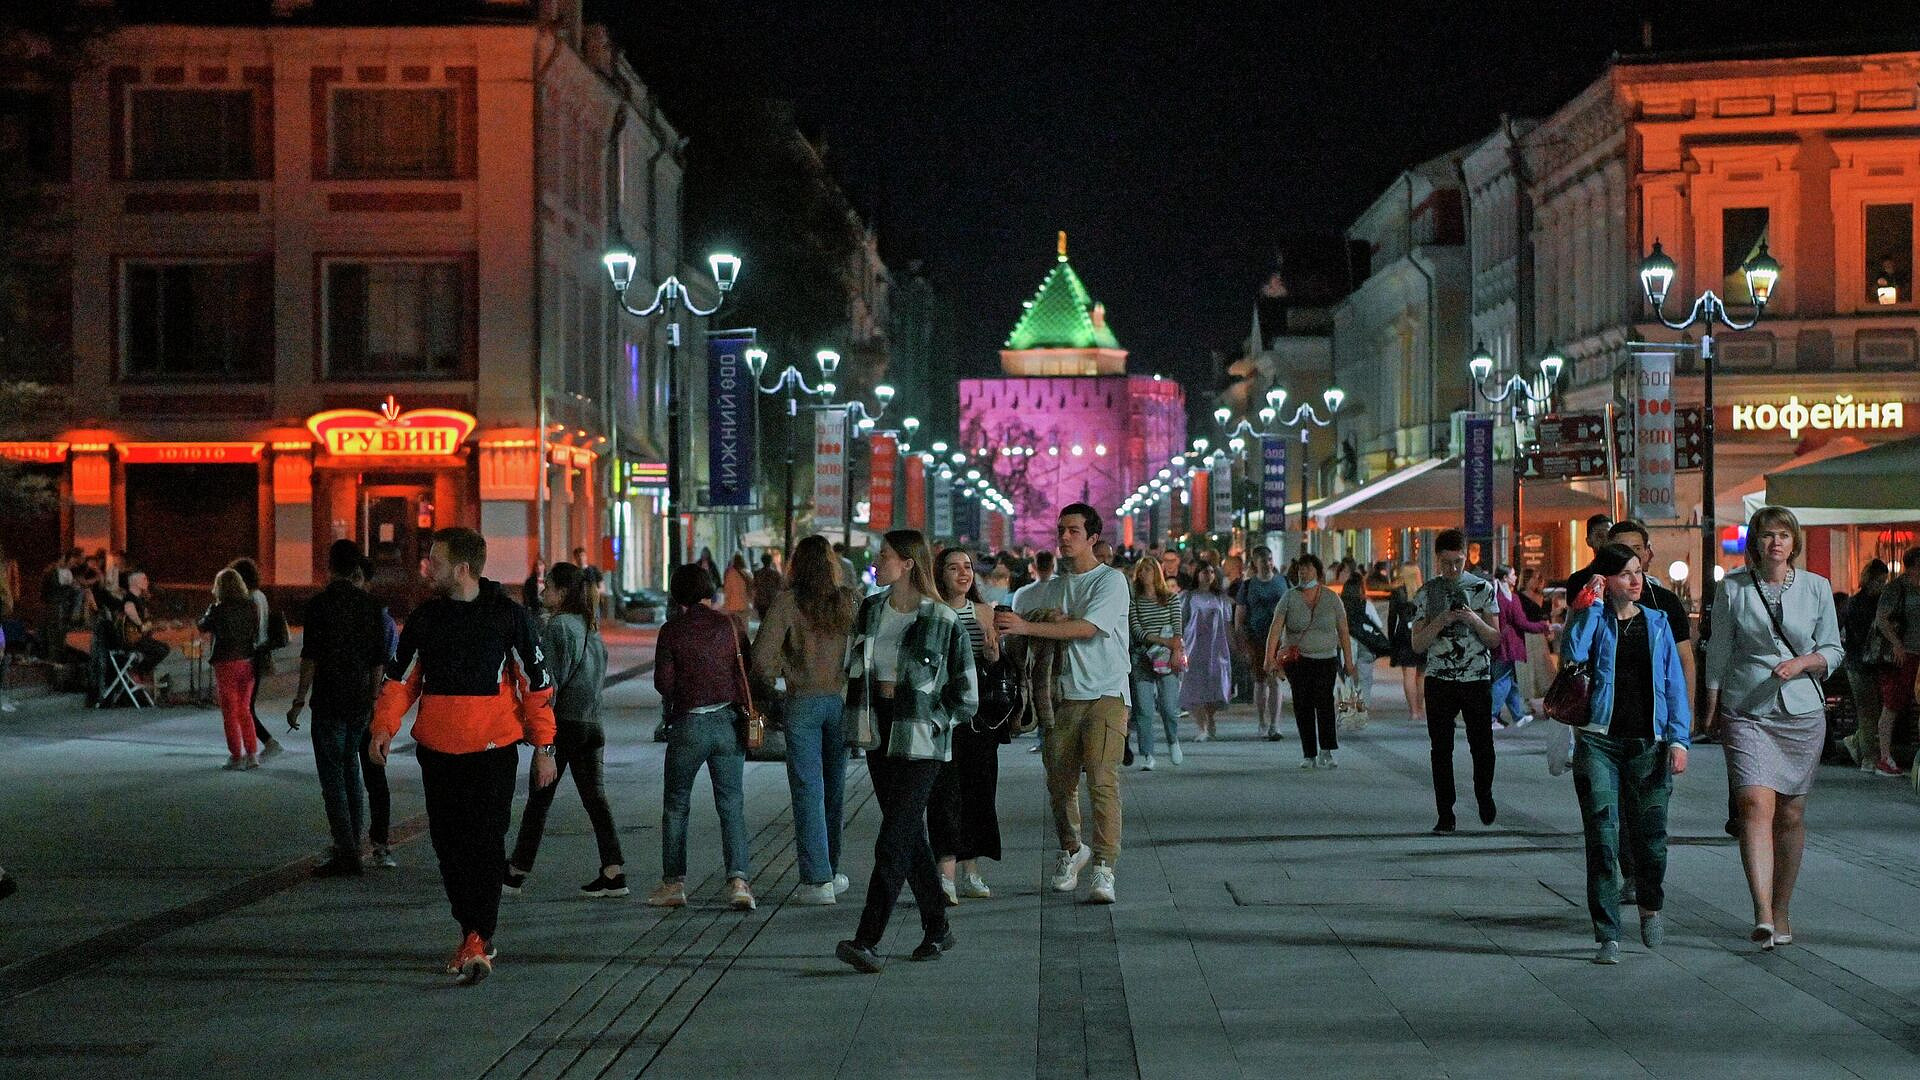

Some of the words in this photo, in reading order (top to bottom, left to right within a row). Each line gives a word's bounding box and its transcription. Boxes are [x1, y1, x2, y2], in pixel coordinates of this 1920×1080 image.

[719, 353, 737, 390] 800
[1732, 393, 1904, 440] кофейня
[337, 431, 449, 451] РУБИН
[1638, 487, 1671, 504] 800
